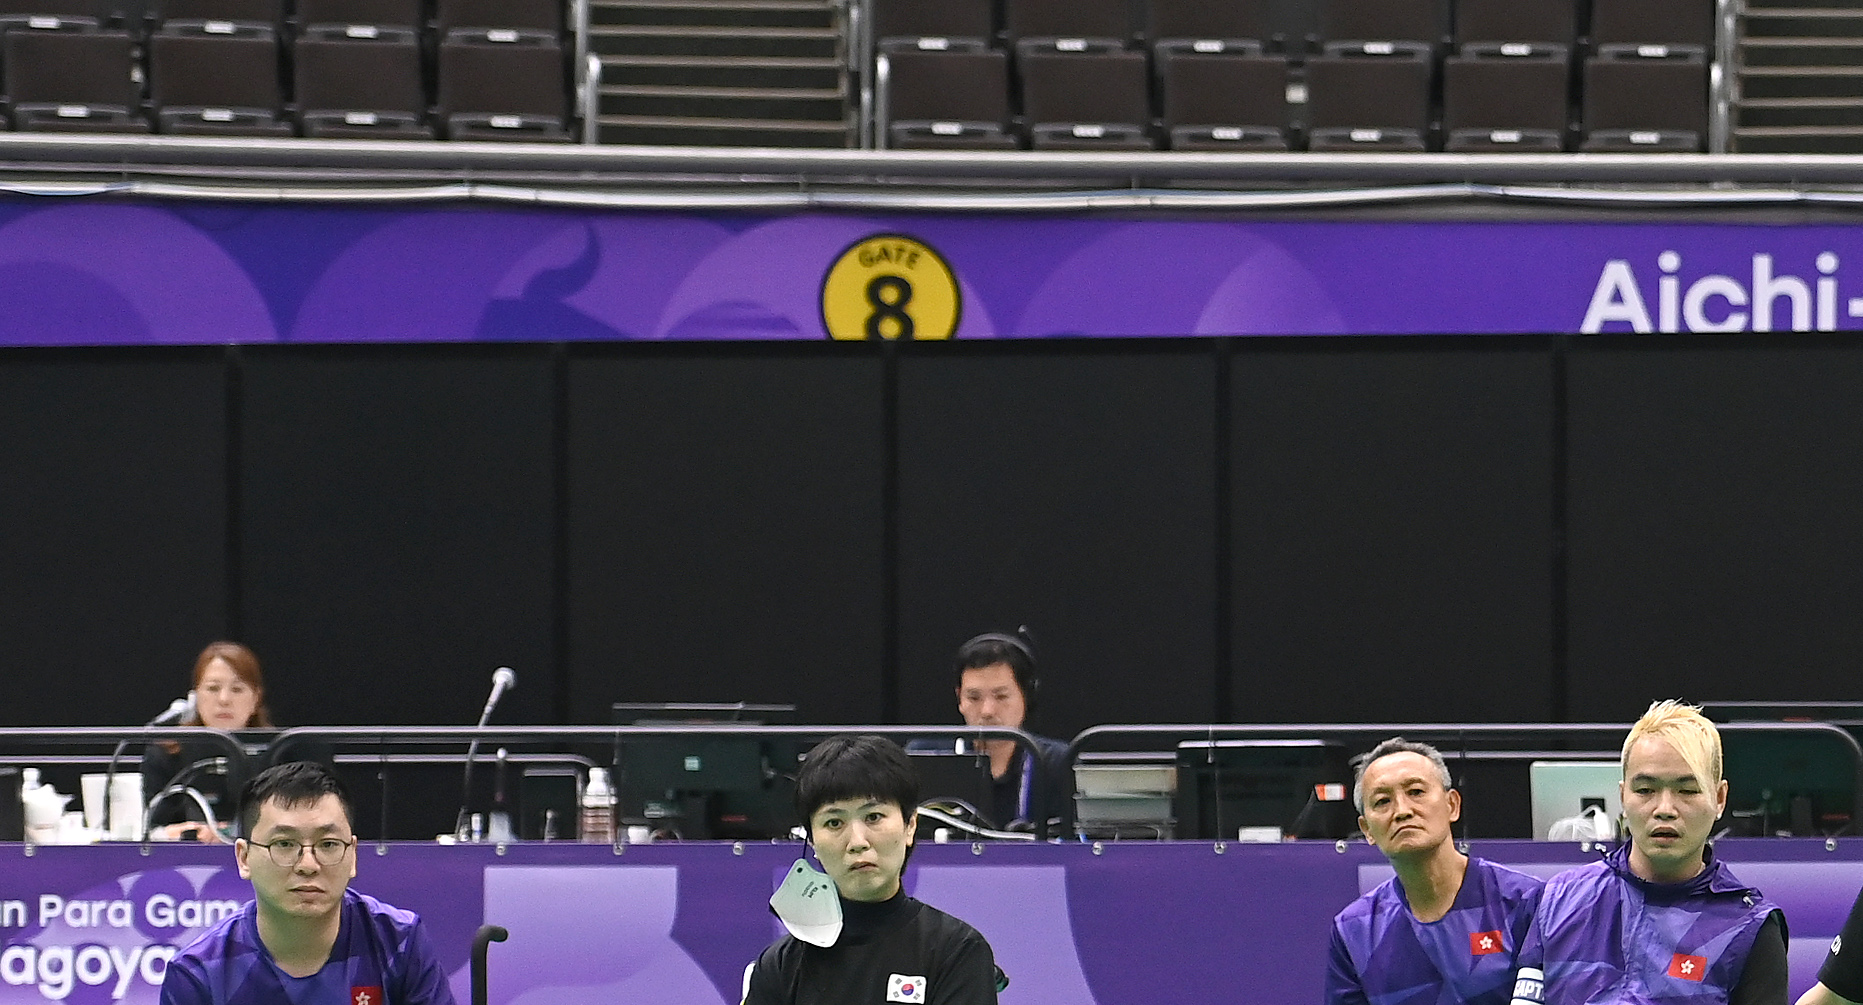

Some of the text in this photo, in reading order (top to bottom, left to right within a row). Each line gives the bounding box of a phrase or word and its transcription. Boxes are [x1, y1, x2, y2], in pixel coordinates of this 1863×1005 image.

[858, 245, 920, 270] GATE
[866, 275, 914, 340] 8
[39, 894, 132, 928] Para
